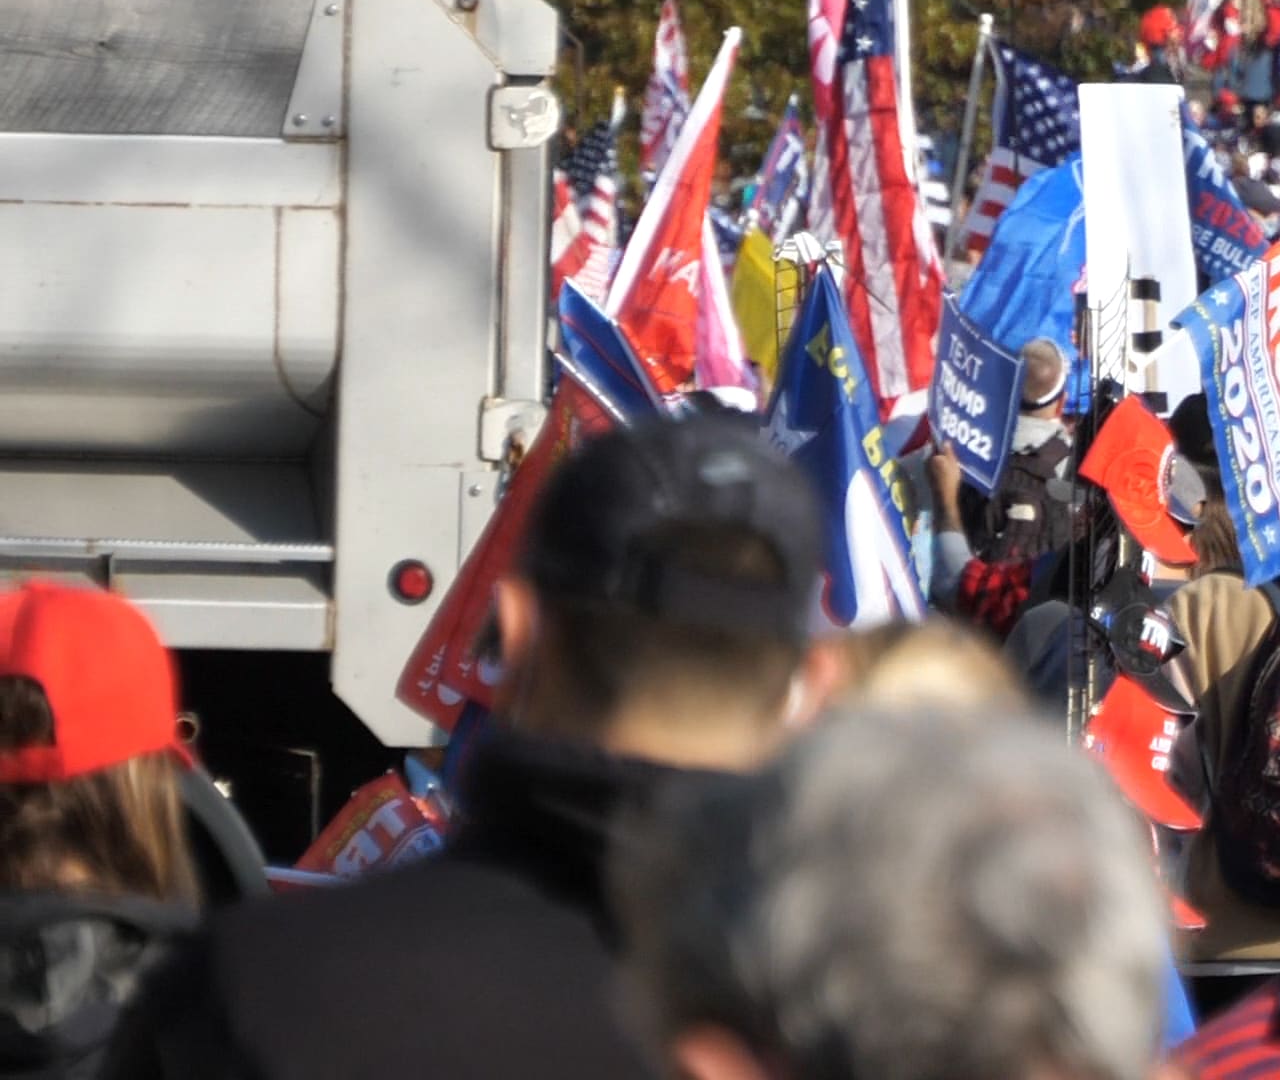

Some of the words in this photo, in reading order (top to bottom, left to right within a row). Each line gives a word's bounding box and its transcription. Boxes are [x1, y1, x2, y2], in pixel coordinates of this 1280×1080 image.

[941, 359, 987, 418] TRUMP
[949, 332, 984, 382] TEXT
[1249, 331, 1280, 444] AMERICA
[1219, 319, 1273, 515] 2020
